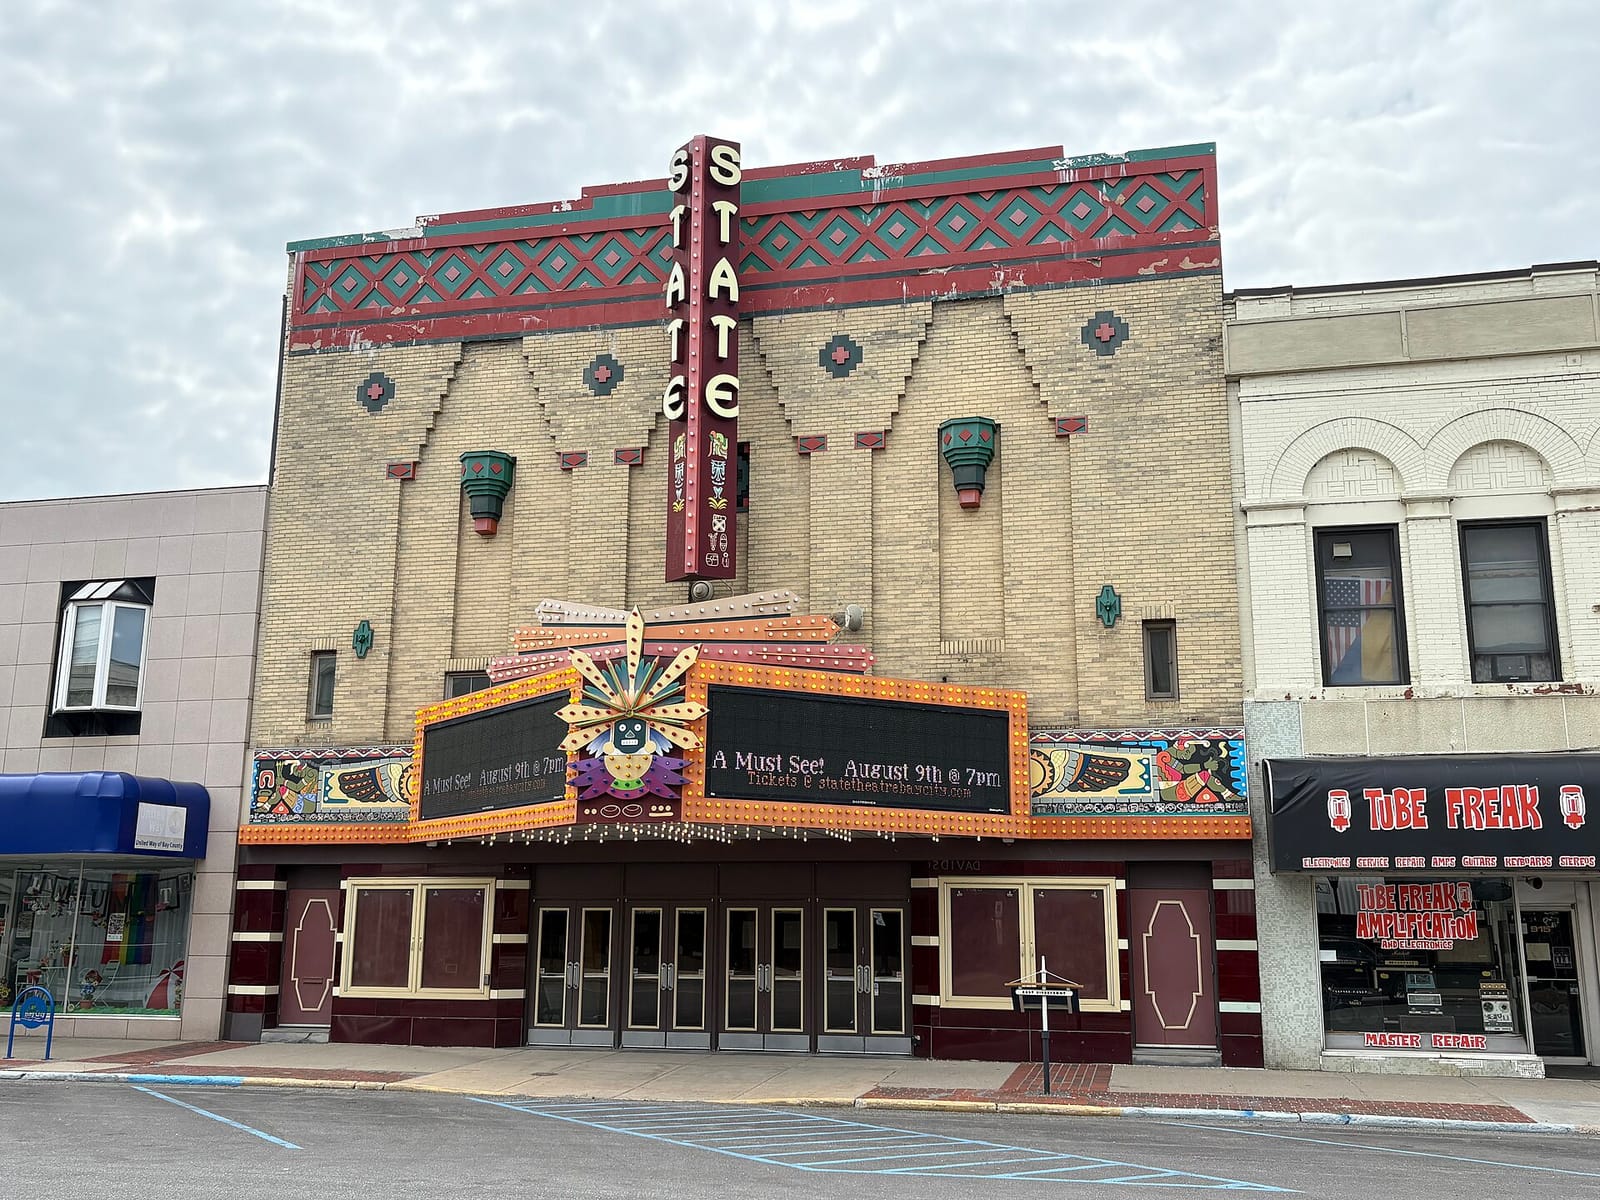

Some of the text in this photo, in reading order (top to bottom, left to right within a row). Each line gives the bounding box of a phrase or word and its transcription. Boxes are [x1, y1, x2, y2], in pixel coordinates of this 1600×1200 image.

[663, 149, 690, 420] STATE
[705, 144, 741, 418] STATE
[424, 779, 430, 796] A
[433, 776, 453, 795] Must
[455, 772, 472, 790] See!
[480, 764, 513, 786] August
[515, 761, 530, 780] 9th
[543, 756, 565, 775] 7pm
[712, 750, 1001, 788] A Must See! August 9th @ 7pm
[748, 770, 797, 788] Tickets
[818, 776, 972, 800] statetheatrebaycity.com
[1363, 784, 1543, 831] TUBE FREAK
[1302, 855, 1596, 869] ELECTRONICS SERVICE REPAIR AMPS GUITARS KEYBOARDS STEREOS
[1356, 882, 1457, 911] TUBE FREAK
[1381, 939, 1454, 950] AND ELECTRONICS
[1364, 1032, 1421, 1048] MASTER
